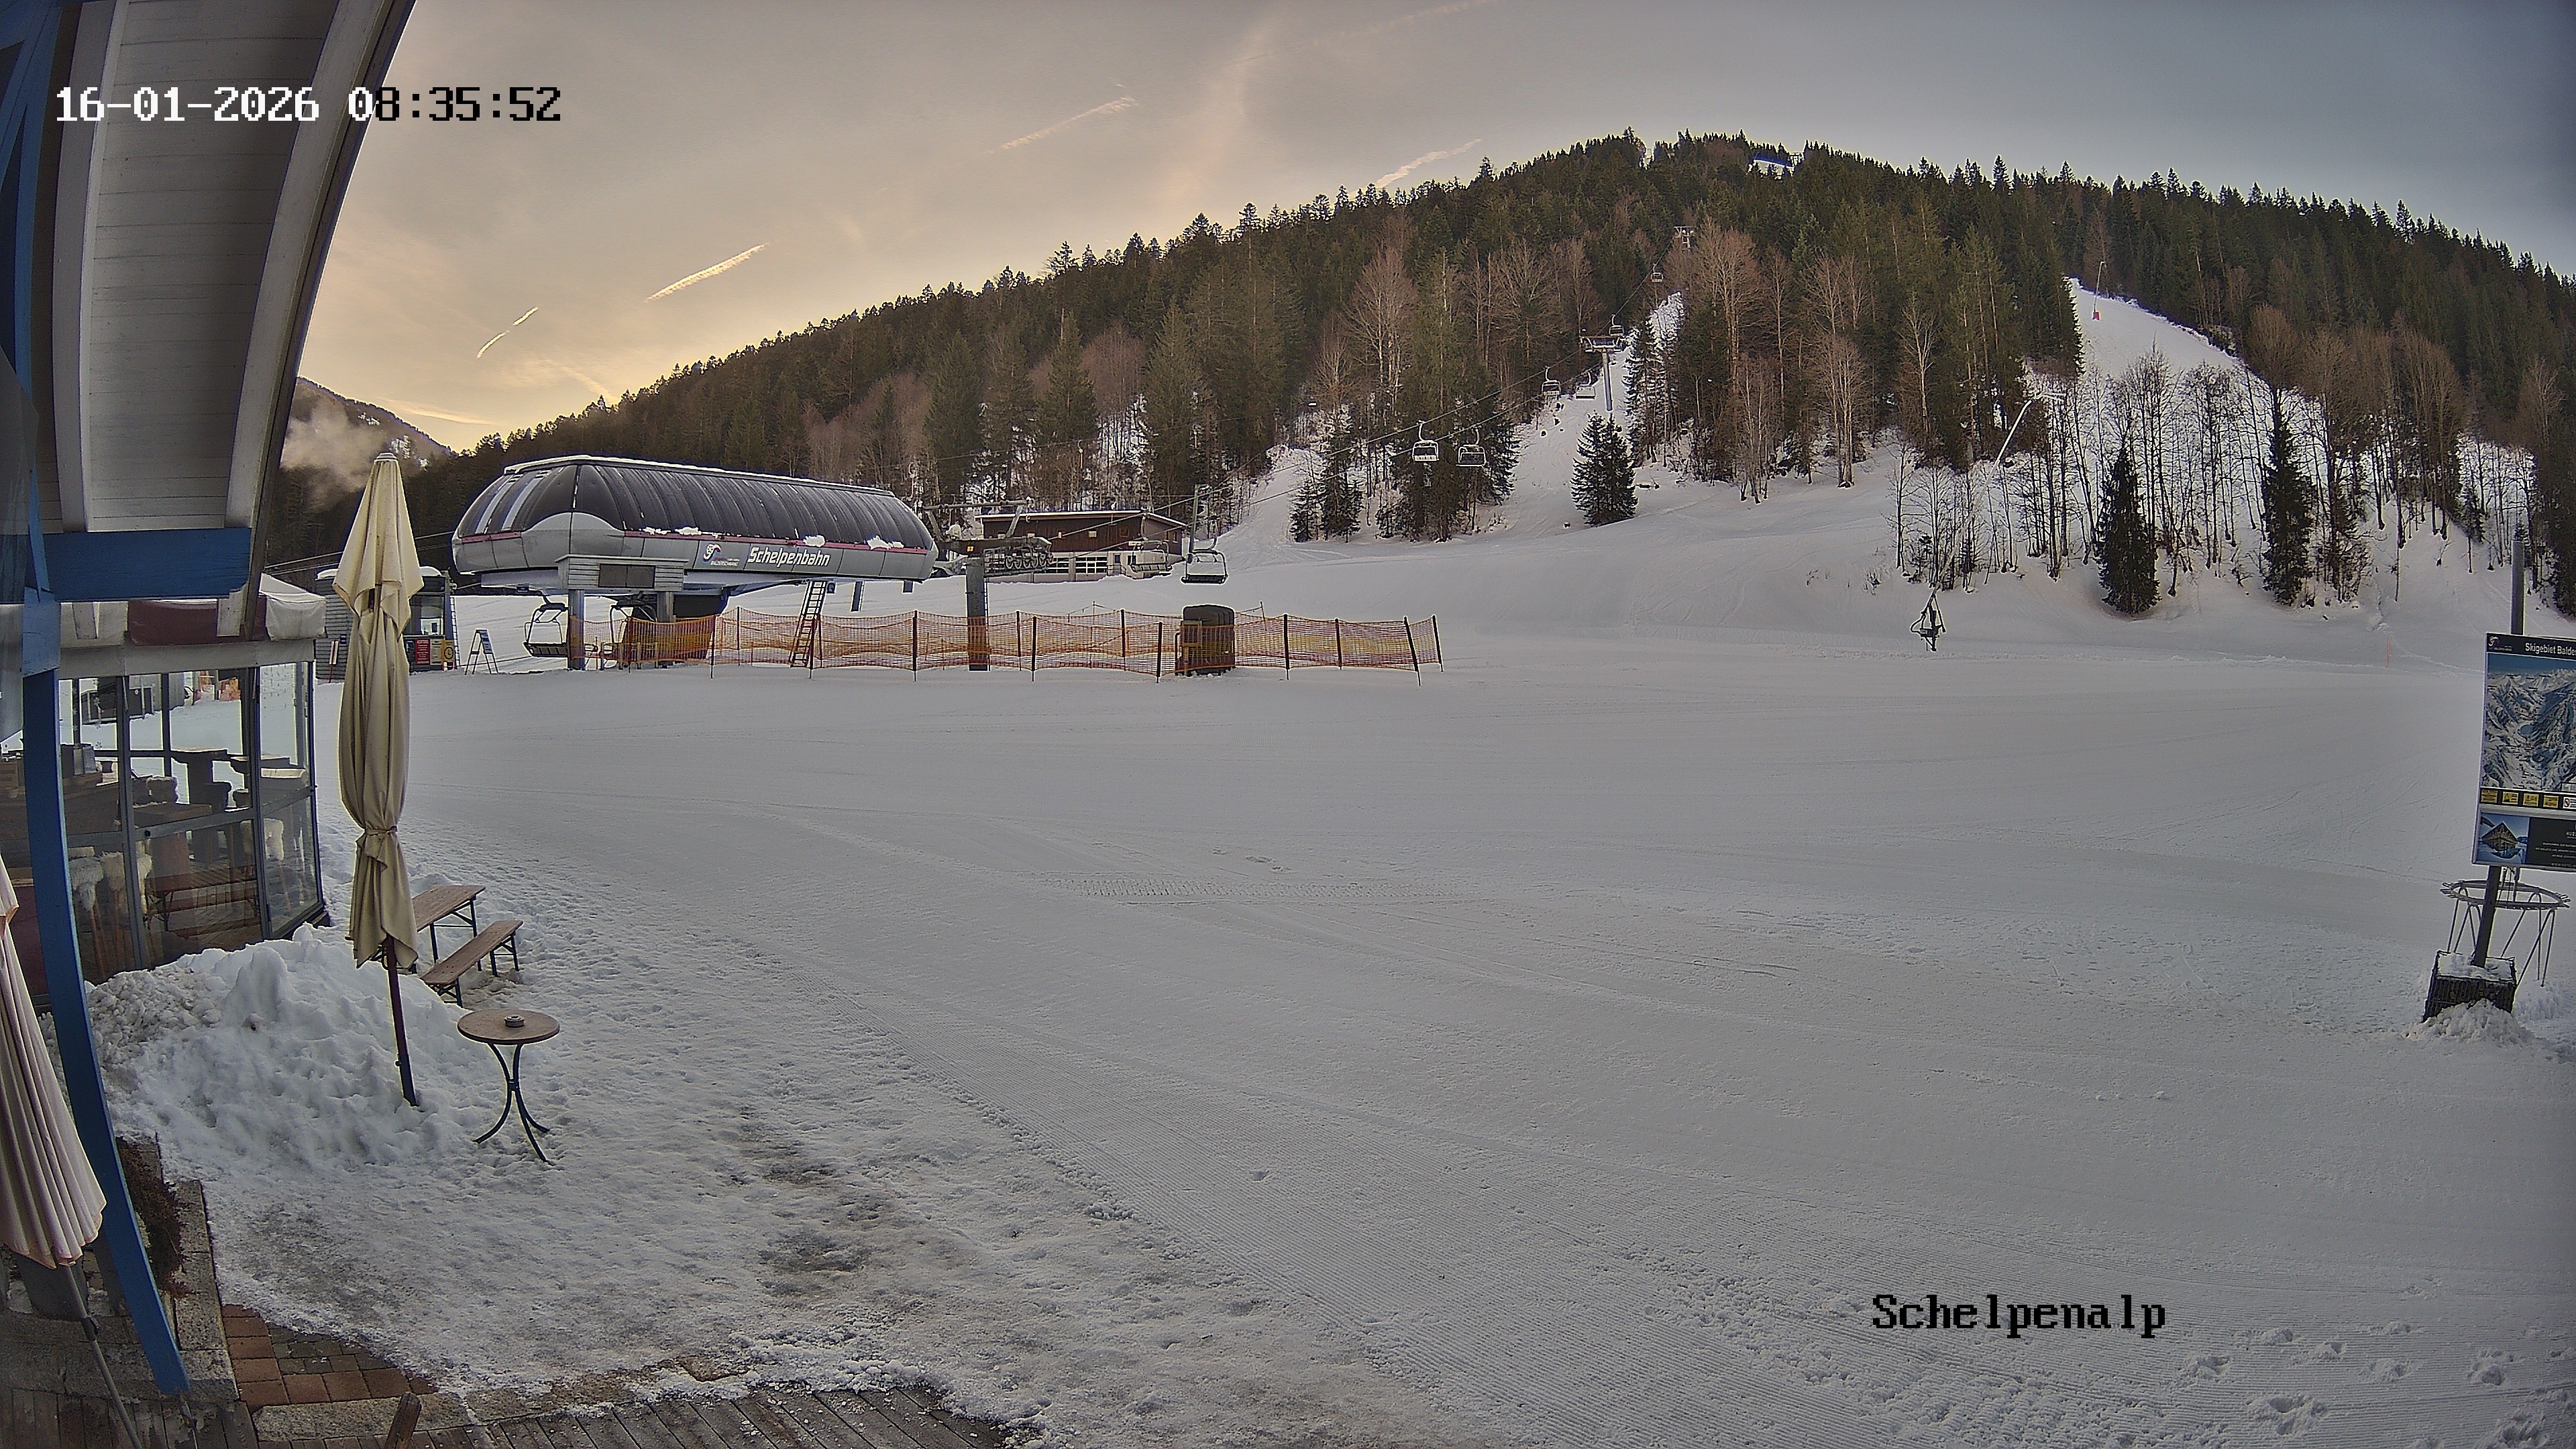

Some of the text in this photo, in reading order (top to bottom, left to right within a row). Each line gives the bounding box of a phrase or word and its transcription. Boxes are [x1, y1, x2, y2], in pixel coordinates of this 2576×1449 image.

[747, 547, 830, 567] Schelpenbahn
[2525, 643, 2576, 655] Skigebiet Balde
